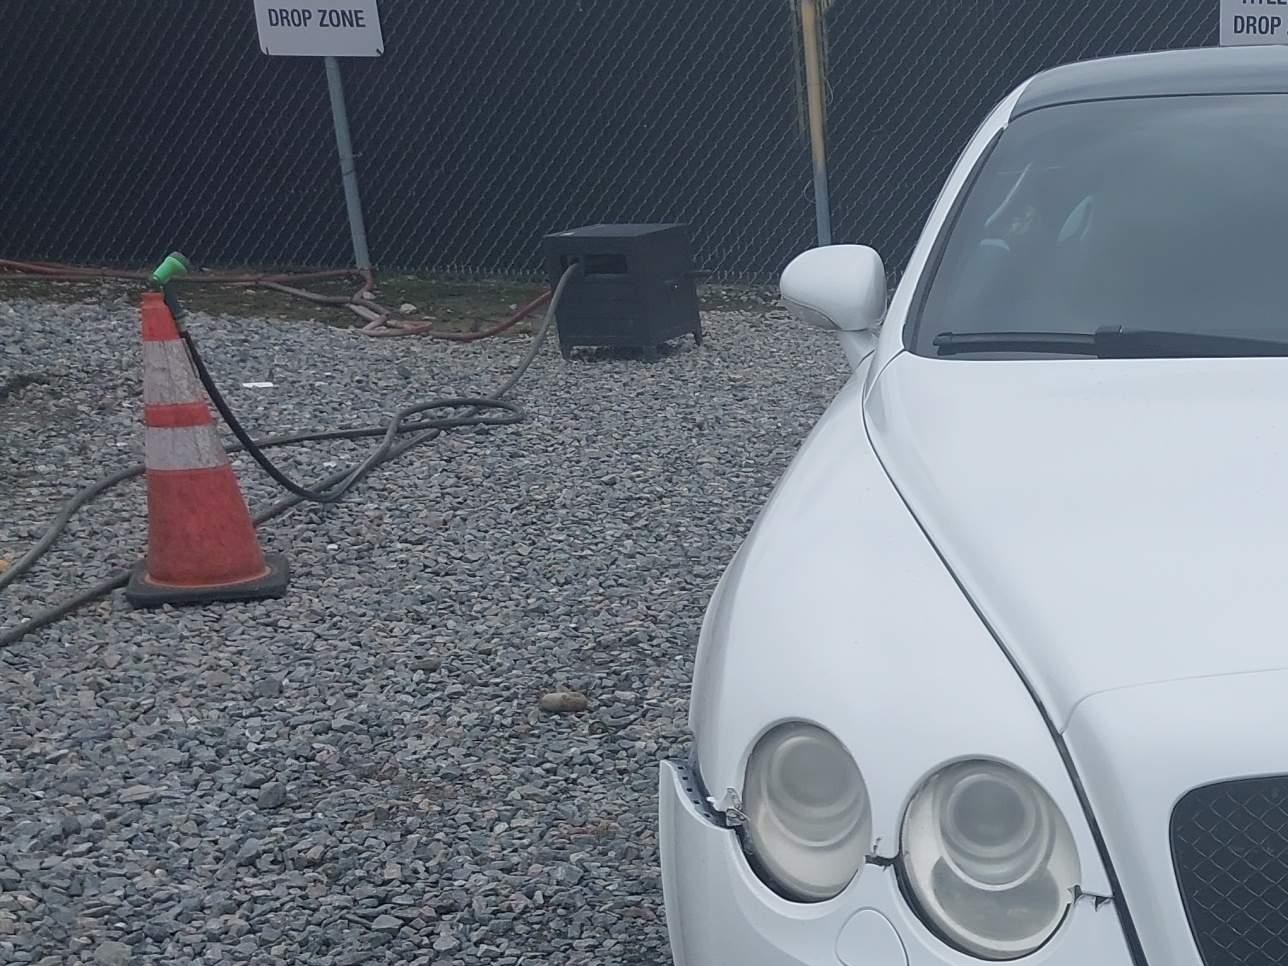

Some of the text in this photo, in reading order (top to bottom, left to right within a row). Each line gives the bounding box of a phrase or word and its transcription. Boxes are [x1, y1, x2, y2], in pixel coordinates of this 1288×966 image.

[268, 8, 366, 28] DROP ZONE
[1233, 15, 1282, 35] DROP
